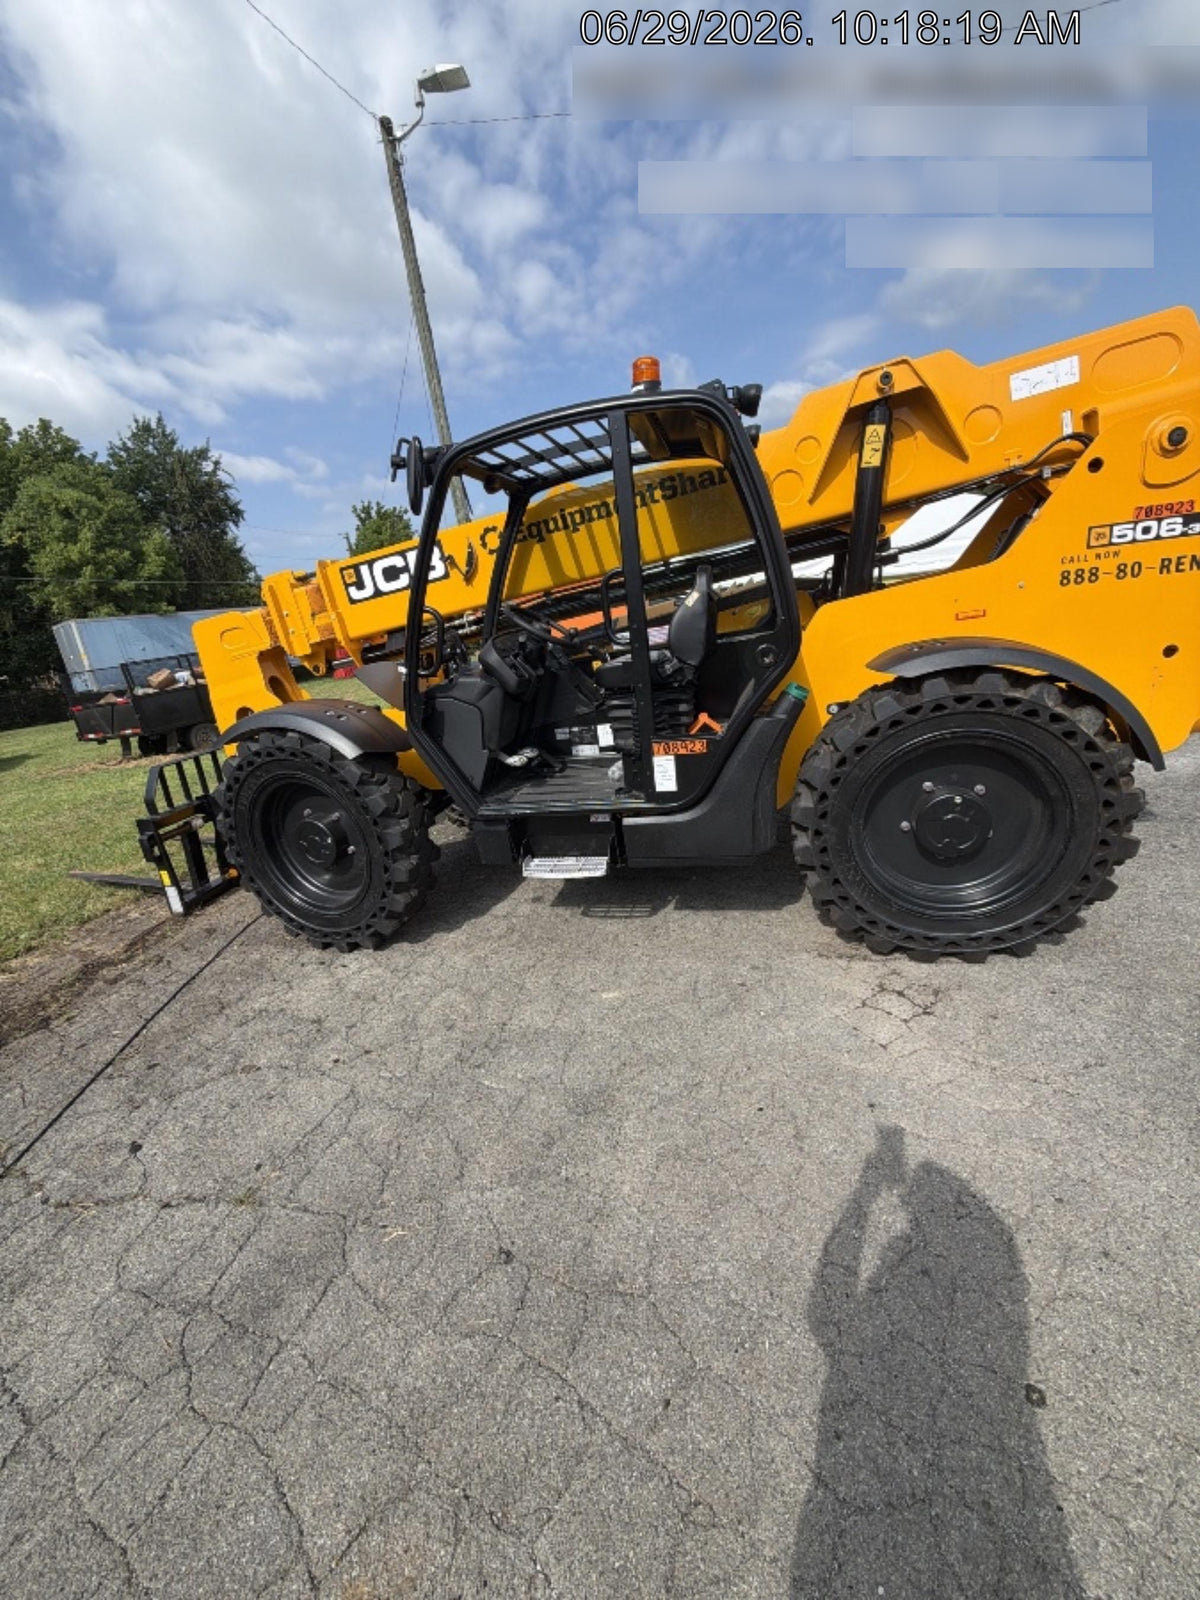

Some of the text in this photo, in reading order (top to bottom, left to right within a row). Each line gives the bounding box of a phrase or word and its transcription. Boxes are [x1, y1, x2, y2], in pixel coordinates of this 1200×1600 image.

[512, 467, 728, 542] EquipmntShar
[347, 544, 446, 601] JCB
[1061, 549, 1121, 564] CALL NOW
